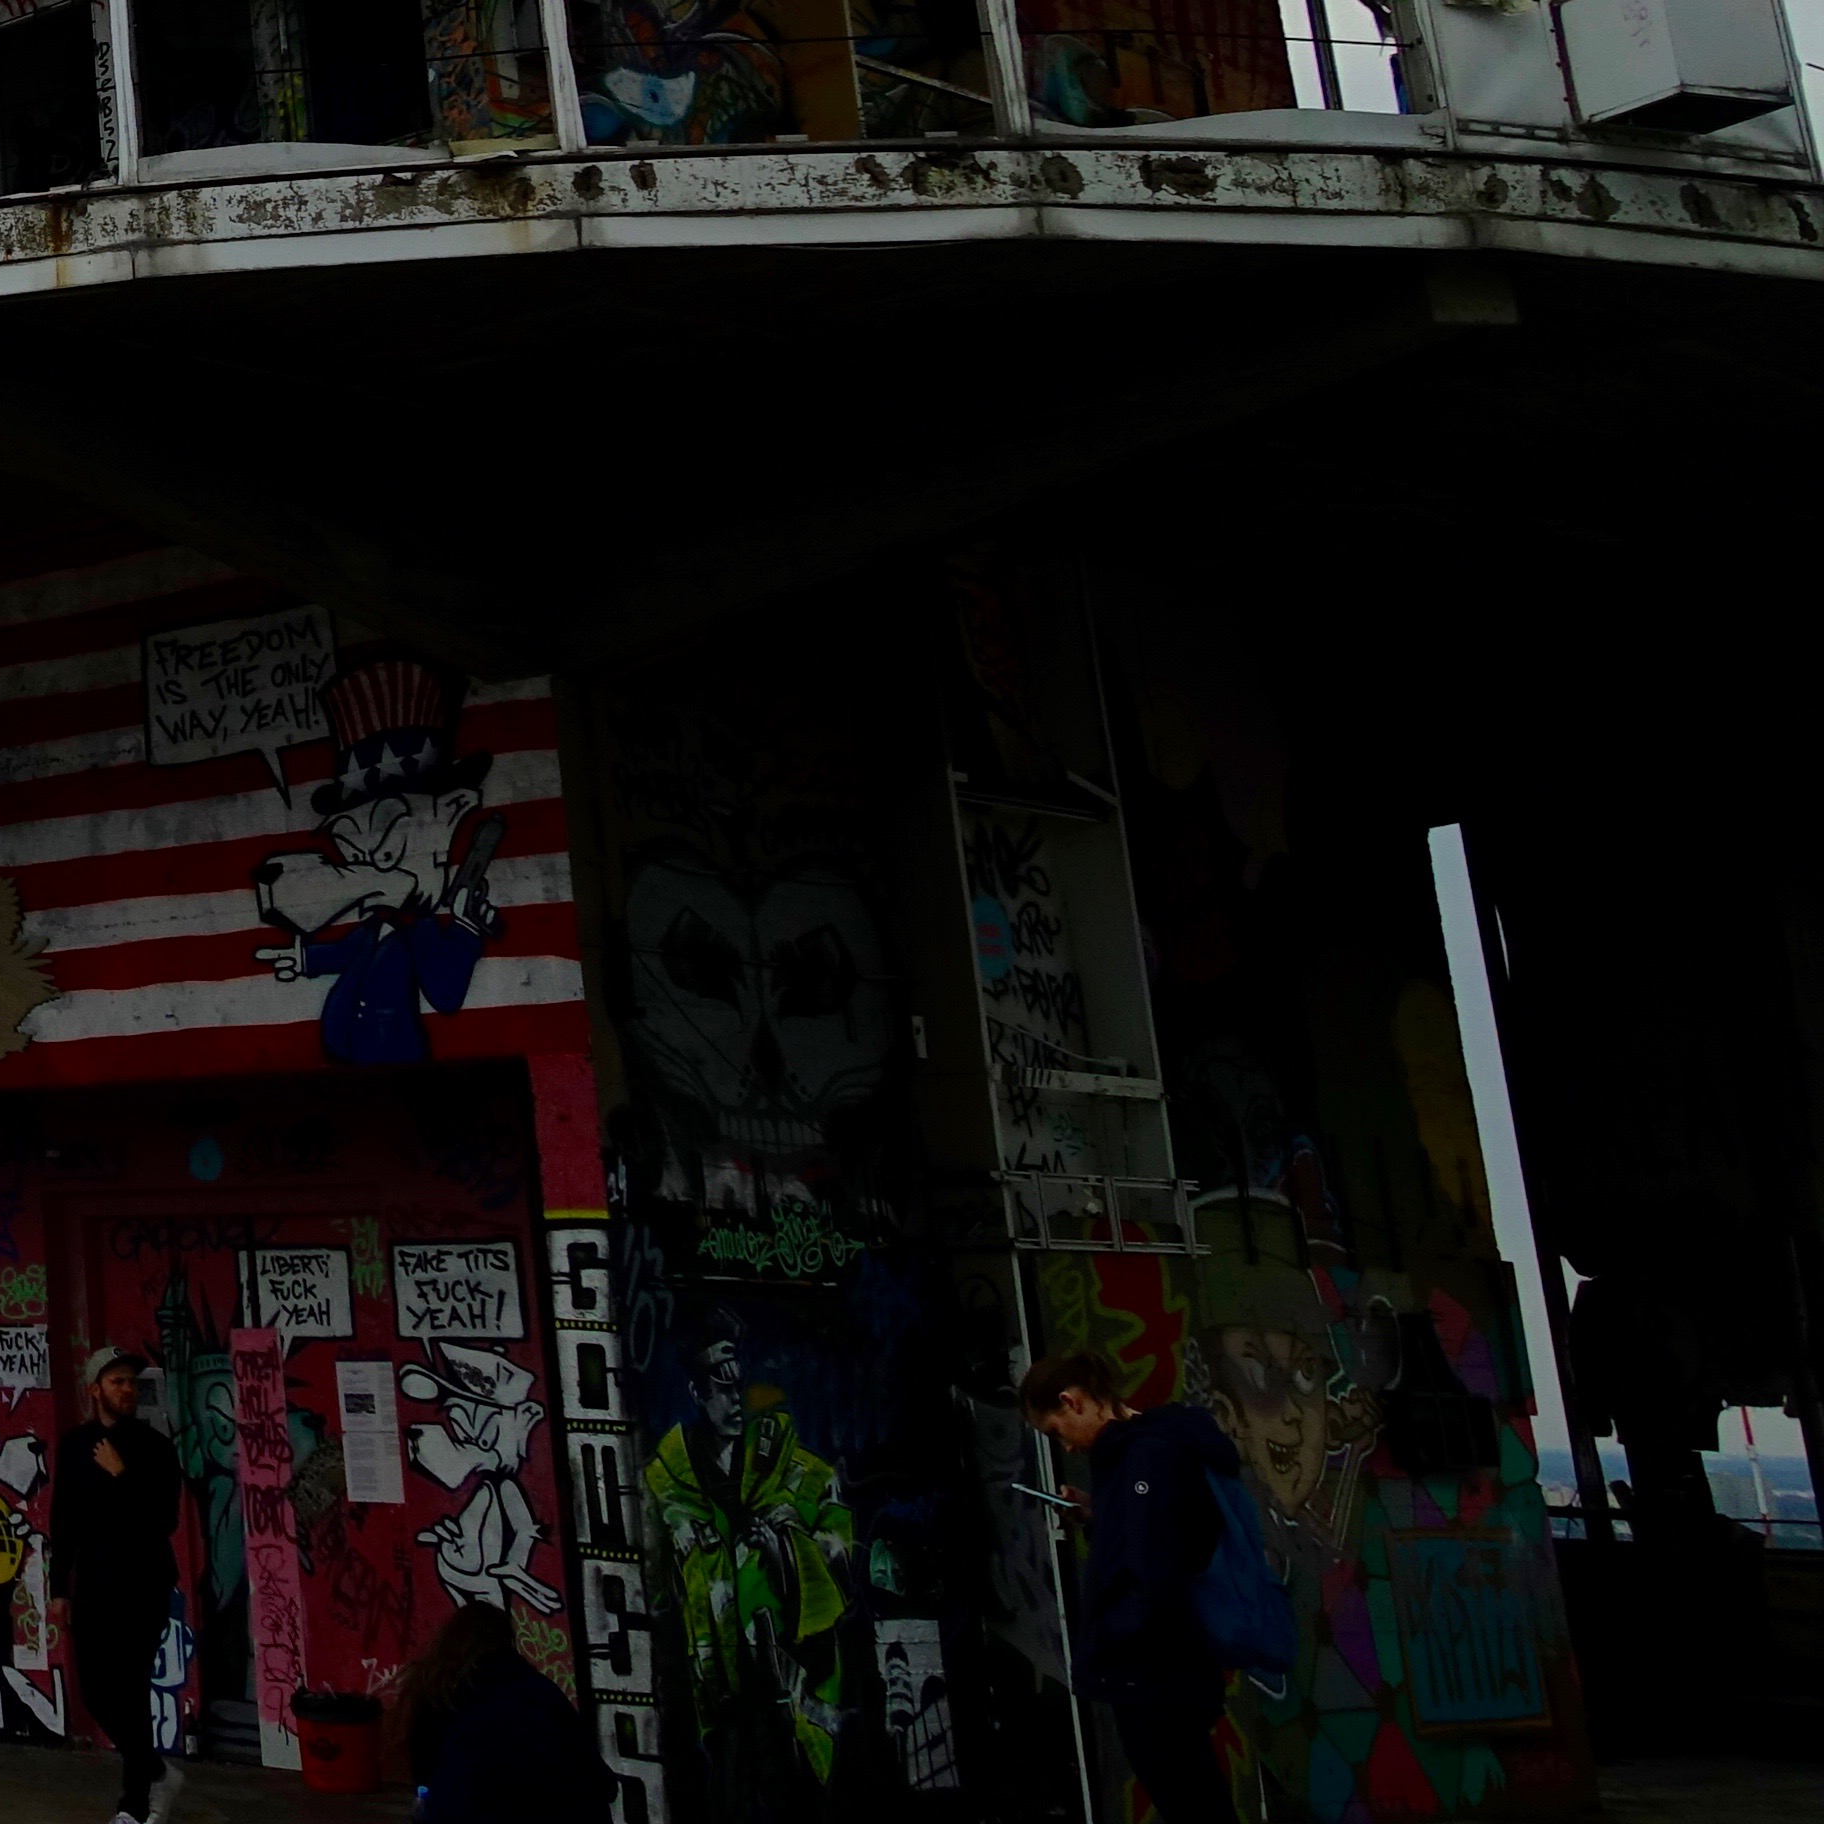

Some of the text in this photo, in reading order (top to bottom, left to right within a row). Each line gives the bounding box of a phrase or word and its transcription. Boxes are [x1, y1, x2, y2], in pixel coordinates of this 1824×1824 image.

[154, 614, 322, 676] FREEDOM
[156, 652, 329, 705] IS THE ONLY
[156, 685, 320, 746] WAY, YEAH!
[398, 1250, 454, 1273] FAKE
[269, 1280, 317, 1301] FUCK
[417, 1280, 495, 1304] FUCK
